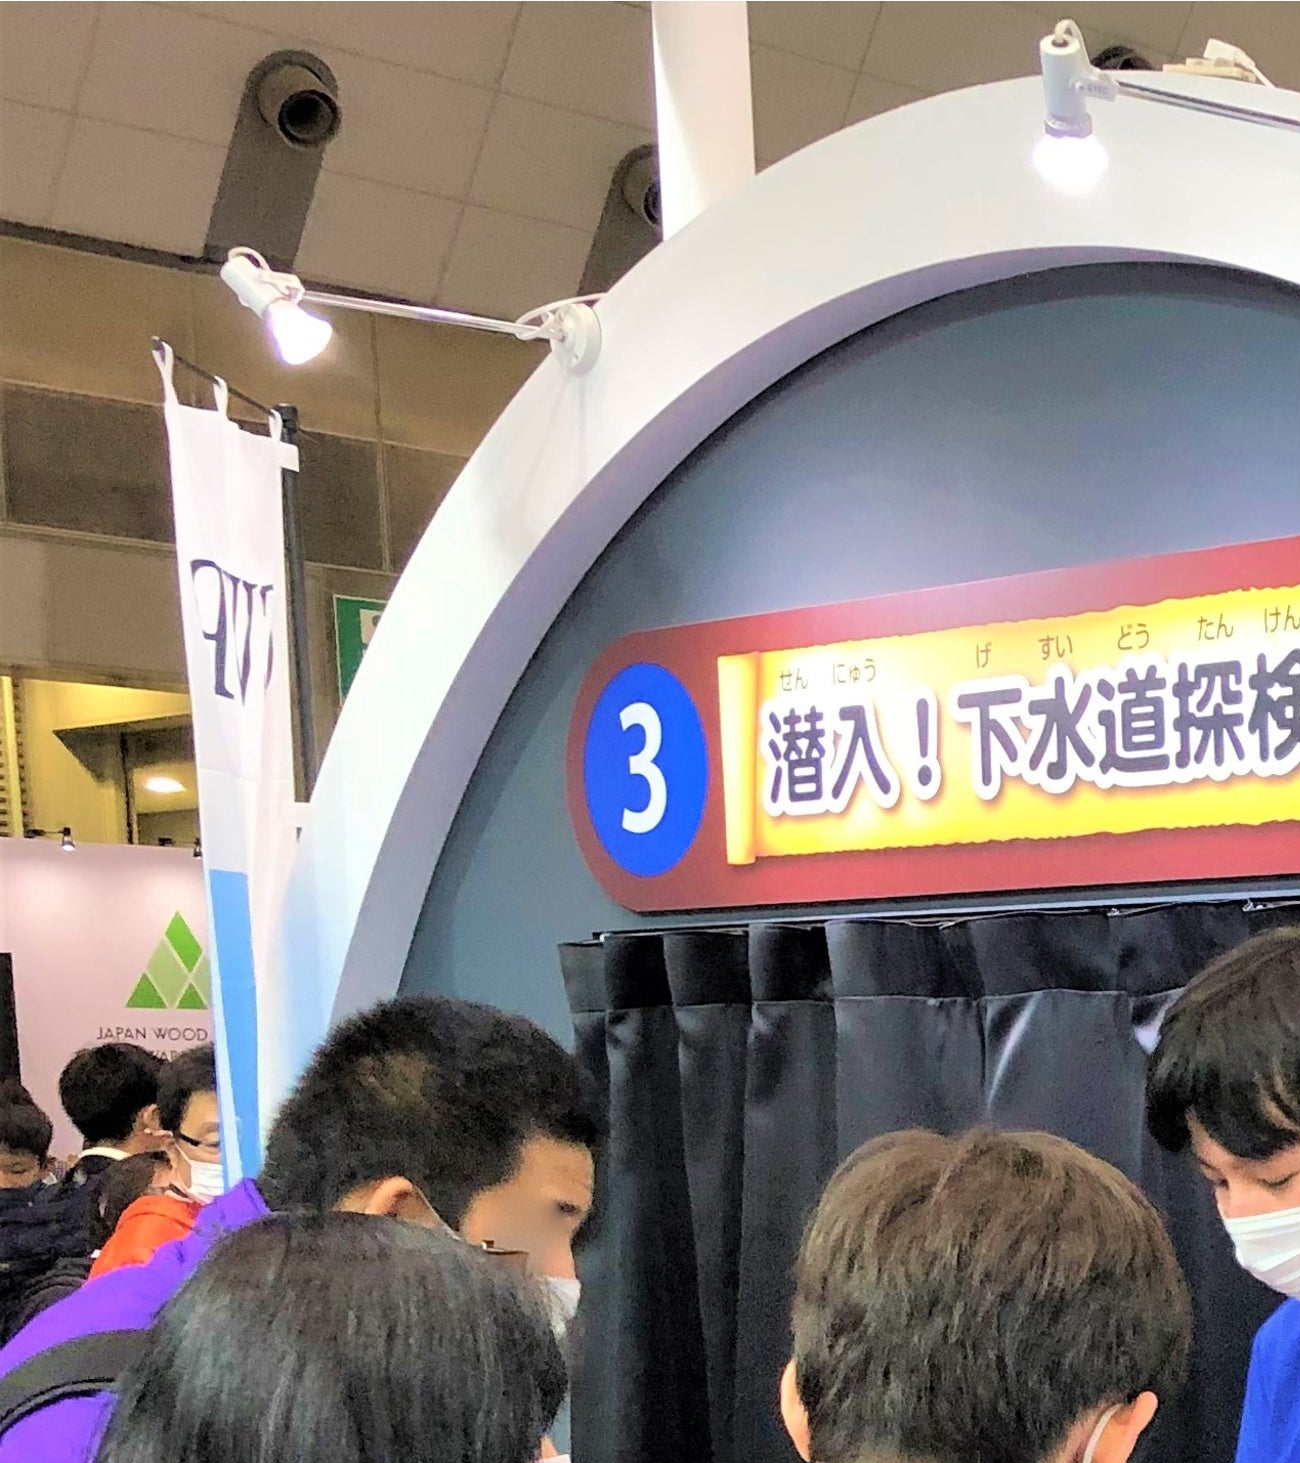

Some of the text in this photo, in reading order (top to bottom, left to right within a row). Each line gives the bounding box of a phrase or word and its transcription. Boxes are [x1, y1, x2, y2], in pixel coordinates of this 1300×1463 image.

[778, 667, 809, 692] せん
[832, 657, 877, 685] にゅう
[975, 640, 992, 668] げ
[1037, 634, 1073, 661] すい
[1116, 622, 1151, 651] どう
[1196, 612, 1235, 641] たん
[618, 701, 668, 835] 3
[96, 1026, 209, 1042] JAPAN WOOD
